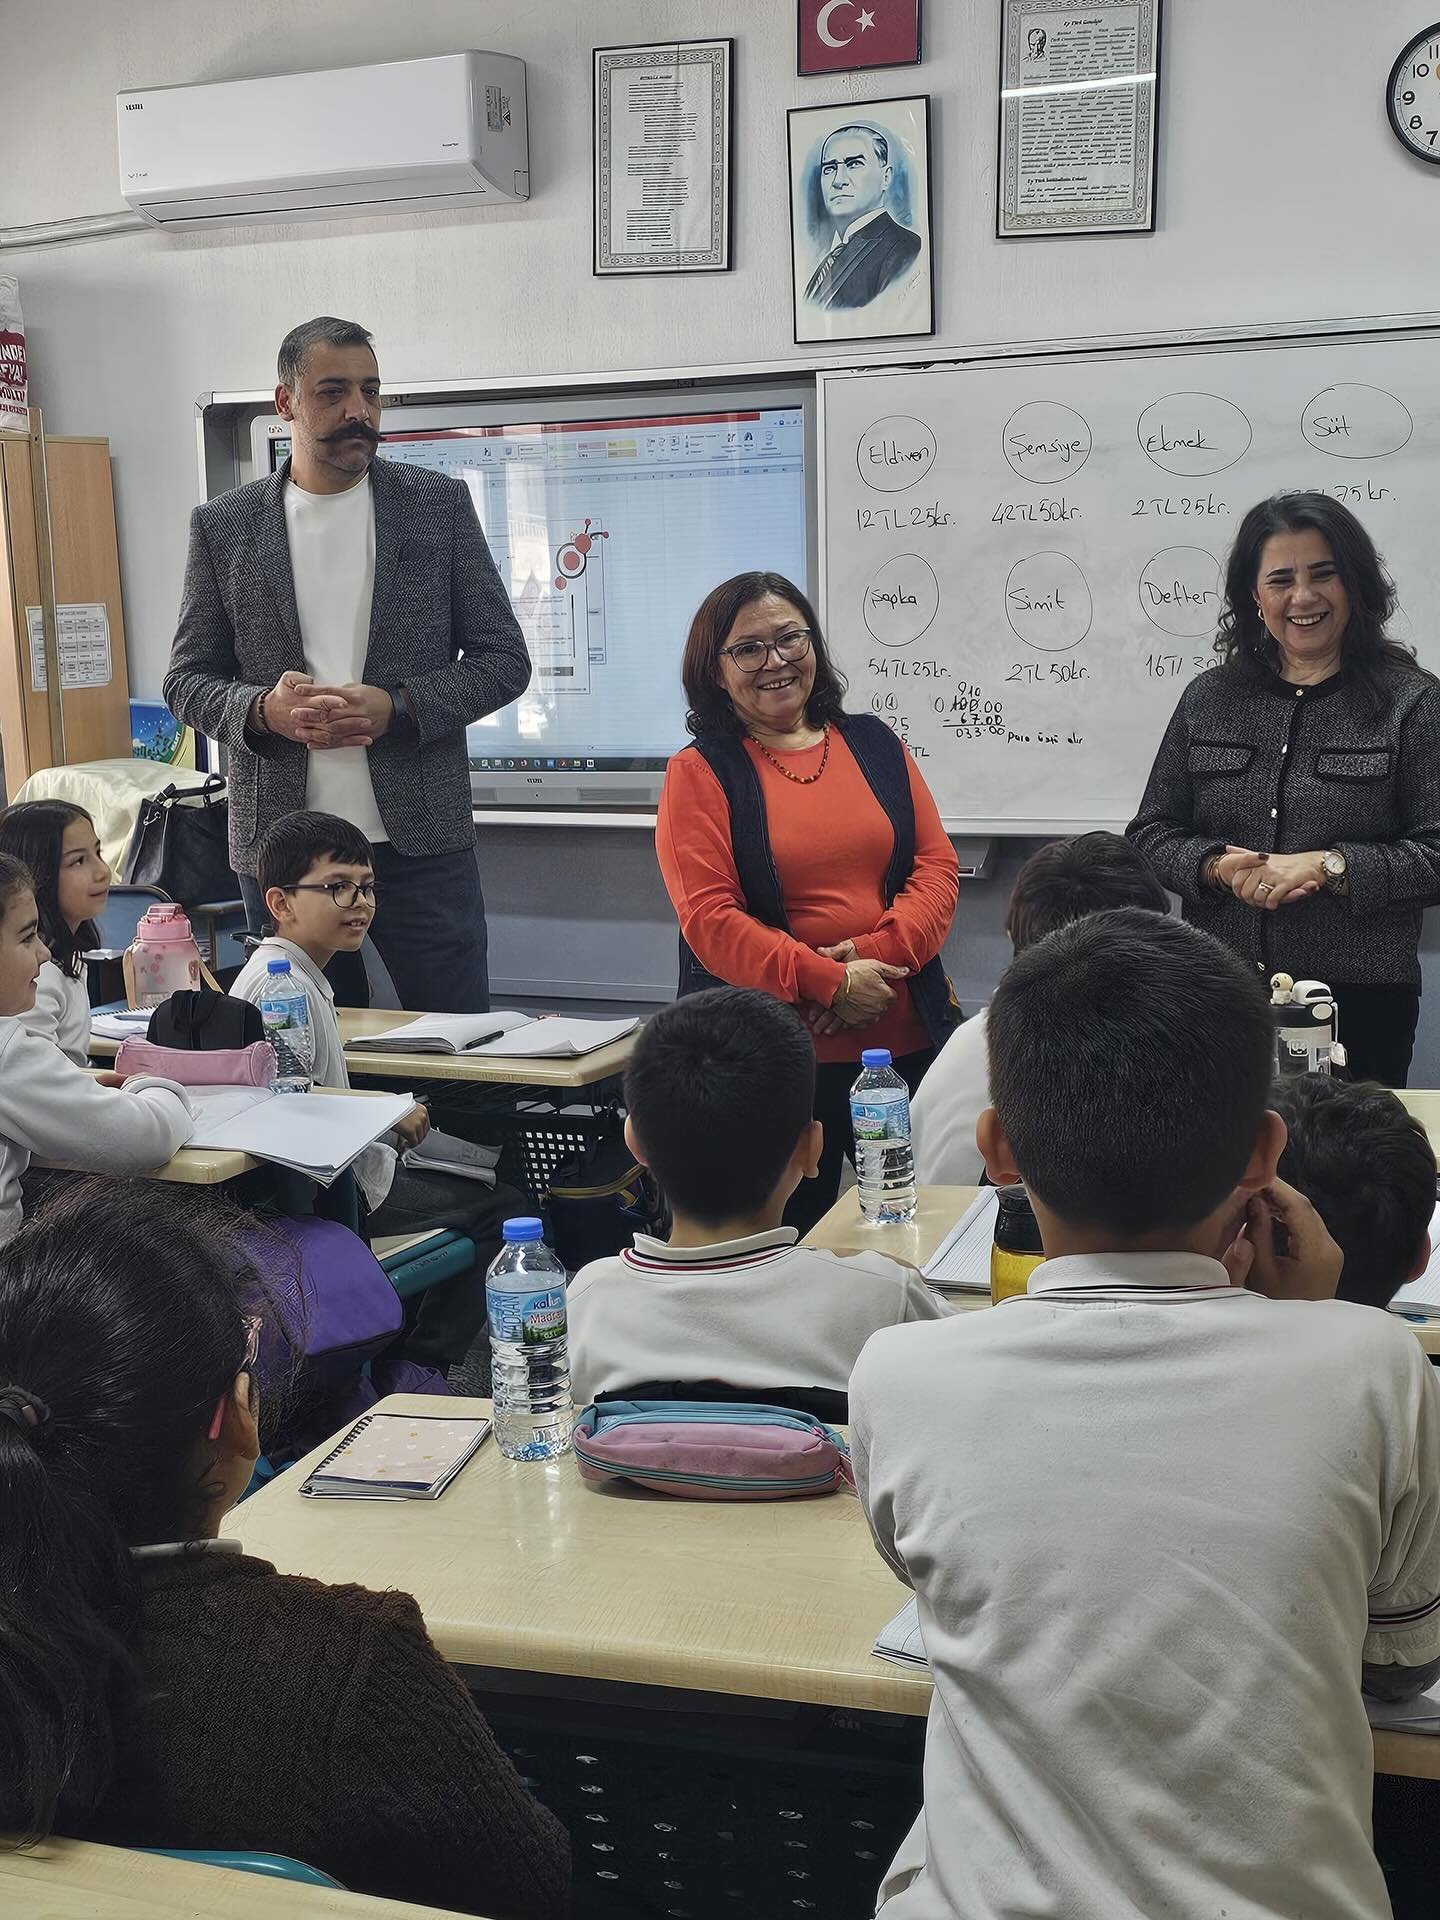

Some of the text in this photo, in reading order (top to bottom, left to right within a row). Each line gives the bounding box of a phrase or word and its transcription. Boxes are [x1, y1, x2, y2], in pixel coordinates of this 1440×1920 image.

[1412, 63, 1430, 79] 10
[1402, 90, 1416, 106] 9
[1409, 115, 1423, 130] 8
[1425, 130, 1439, 146] 7
[1312, 415, 1352, 438] Süt
[1146, 424, 1219, 453] Ekmek
[869, 440, 929, 466] Eldiven
[1143, 580, 1217, 607] Defter
